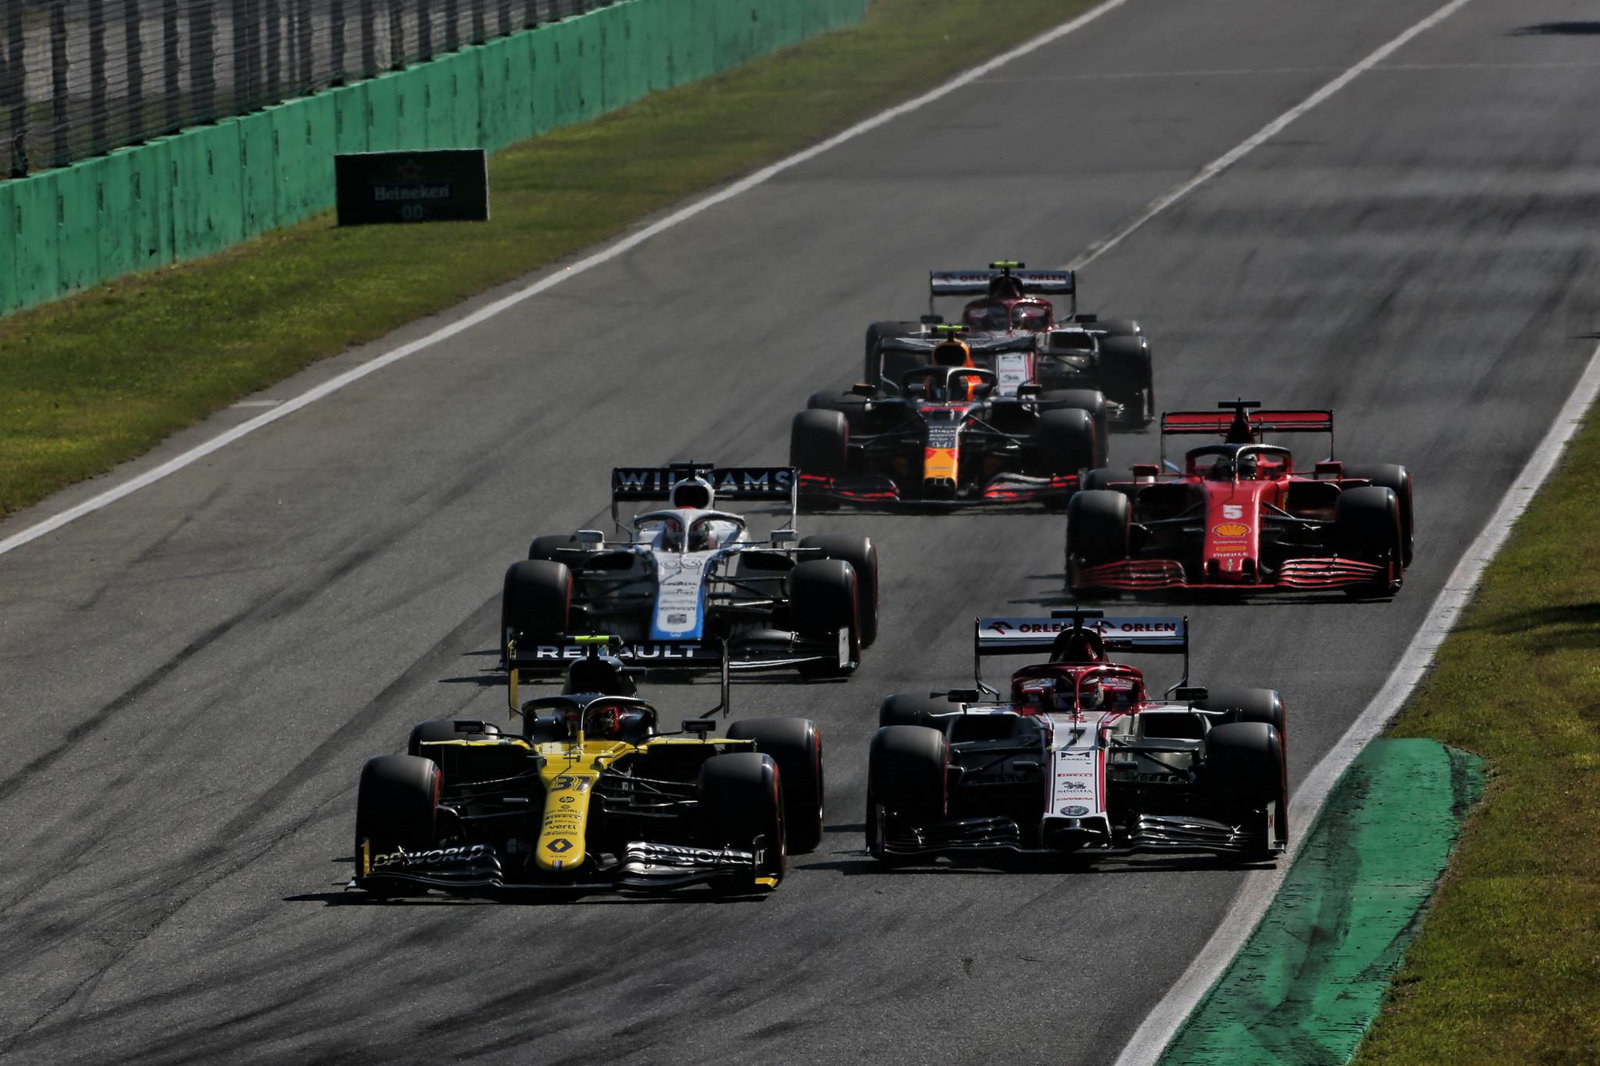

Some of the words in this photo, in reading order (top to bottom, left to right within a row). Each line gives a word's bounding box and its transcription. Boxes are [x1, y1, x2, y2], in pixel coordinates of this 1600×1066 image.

[373, 184, 449, 201] Heineken
[1223, 504, 1243, 520] 5
[1121, 622, 1176, 632] ORLEN
[1068, 727, 1087, 746] 7
[551, 776, 593, 791] 31
[373, 852, 405, 867] DP
[408, 844, 485, 863] WORLD
